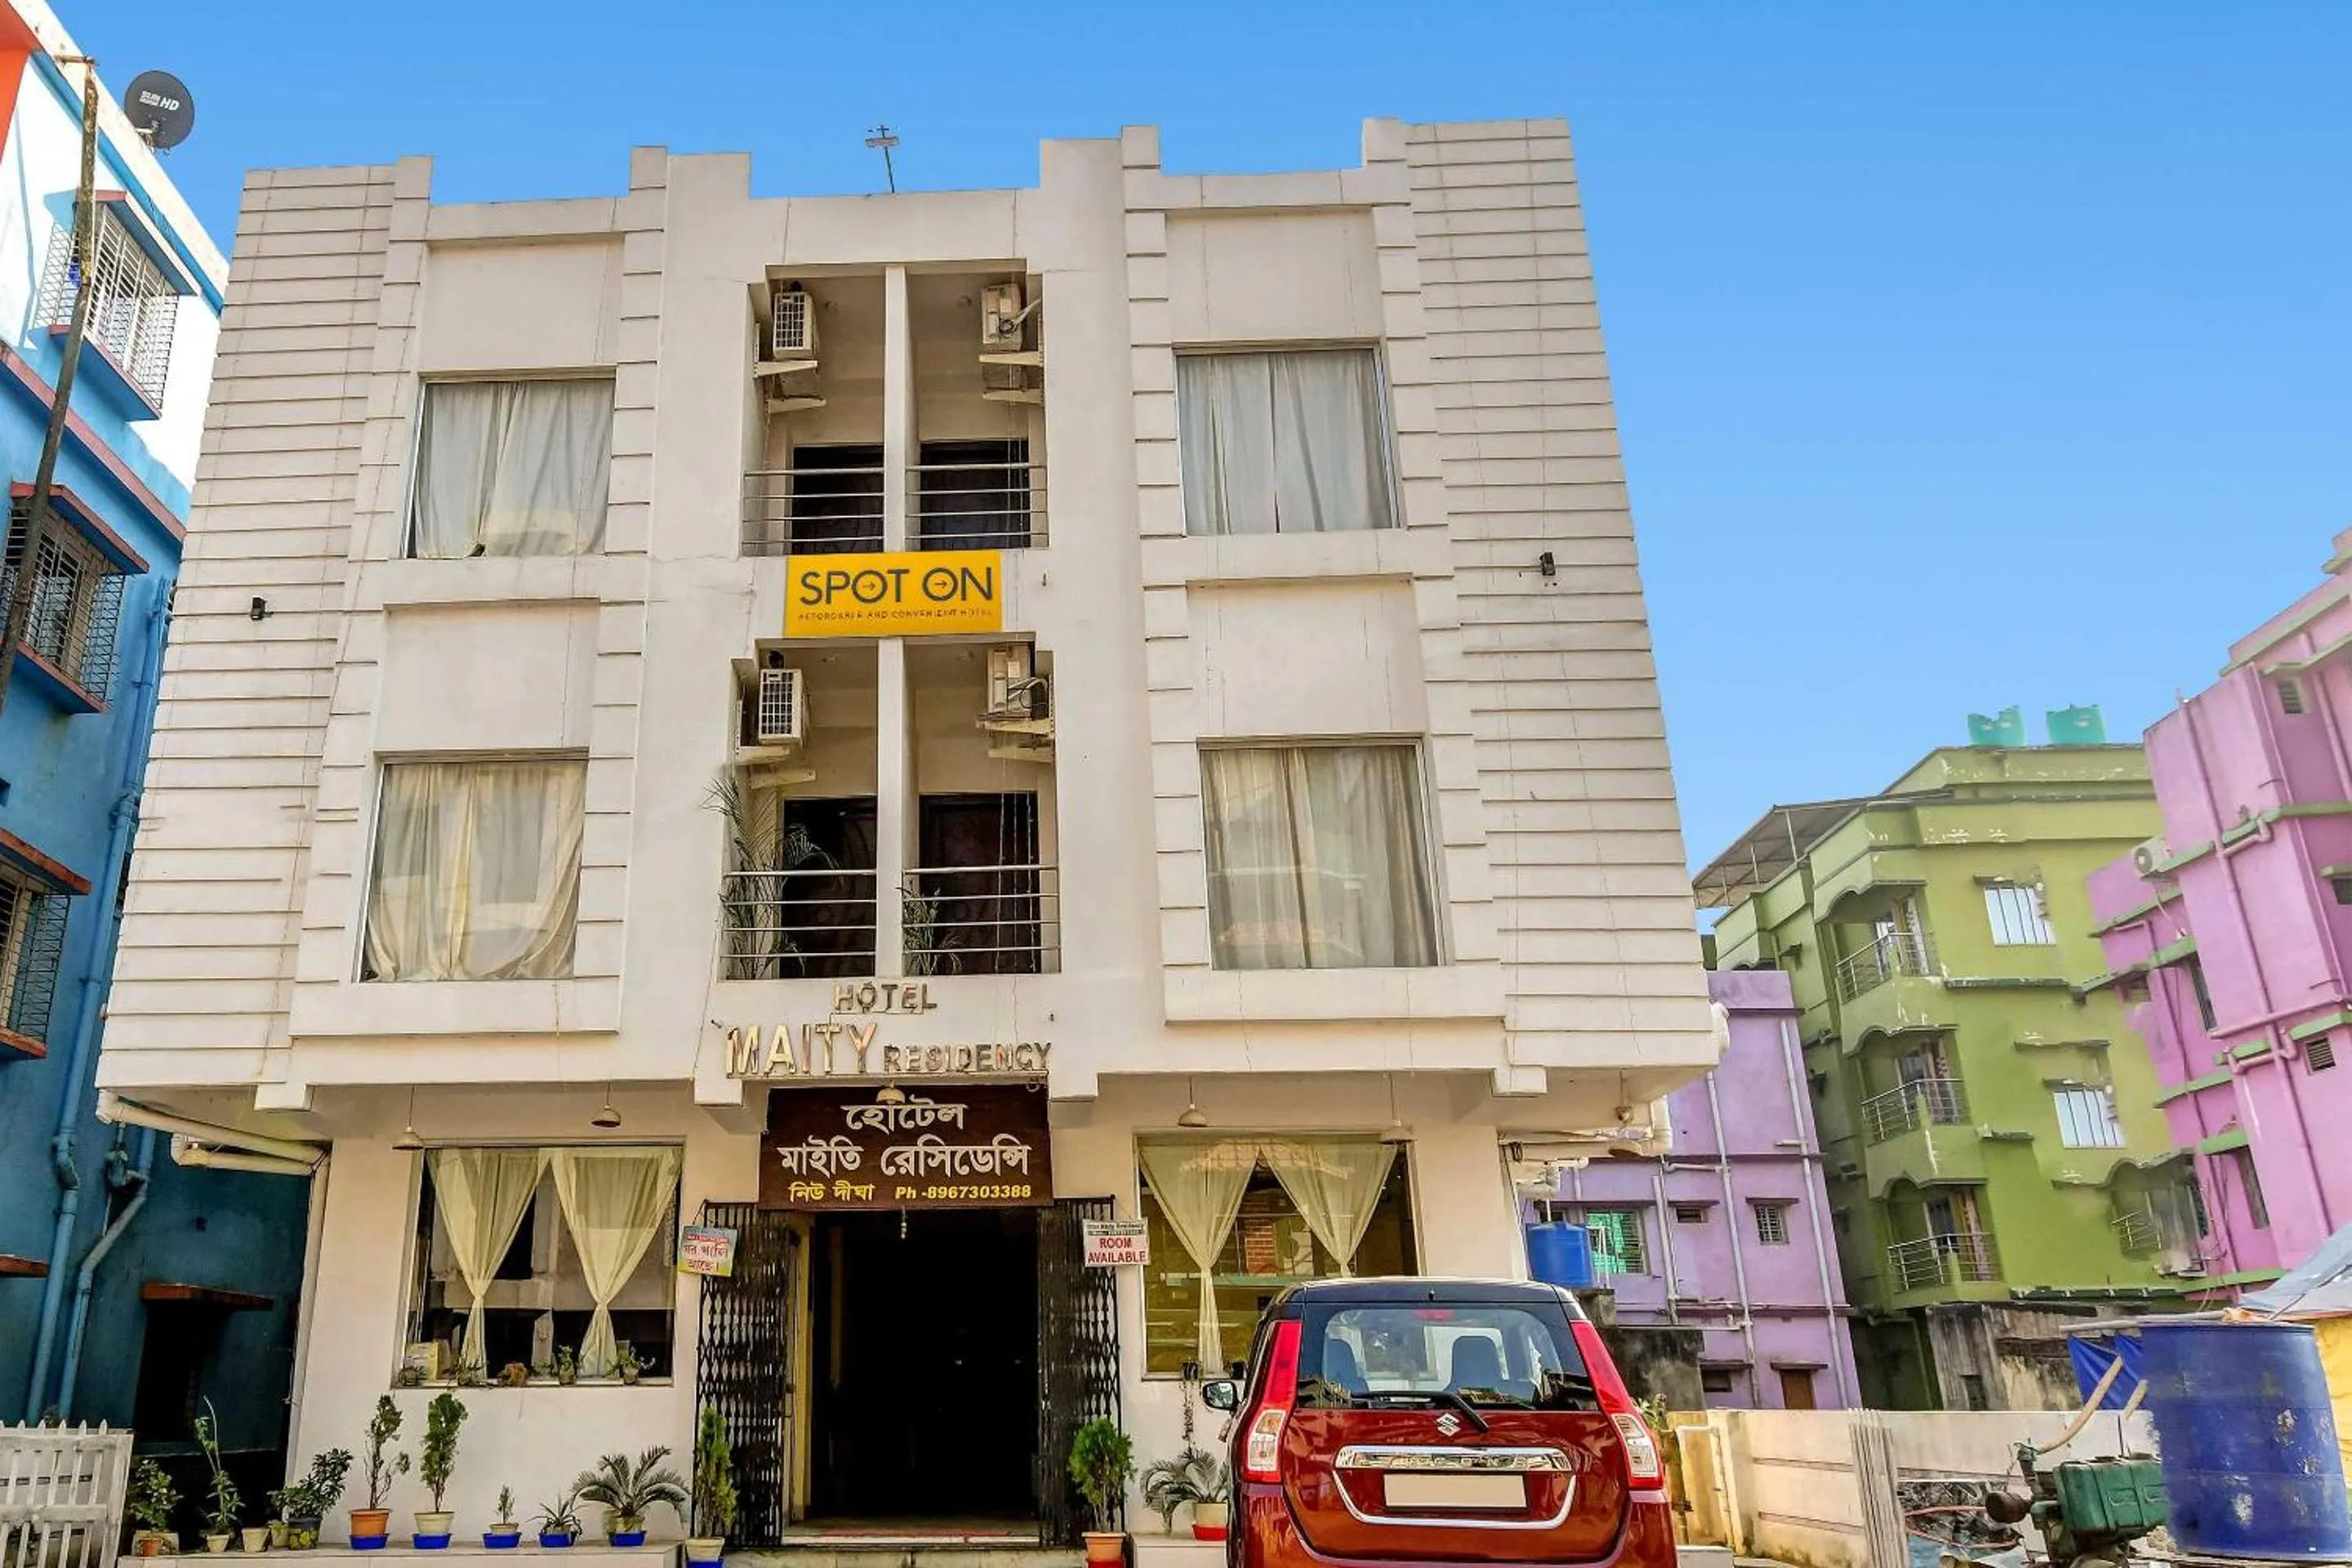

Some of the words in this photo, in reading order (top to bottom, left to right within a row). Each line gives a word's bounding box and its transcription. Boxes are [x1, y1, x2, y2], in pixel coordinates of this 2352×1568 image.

[159, 96, 179, 110] HD
[800, 569, 910, 605] SPOT
[922, 567, 993, 602] ON
[834, 982, 938, 1012] HOTEL
[726, 1022, 877, 1076] MAITY
[884, 1042, 1051, 1072] RESIDENCY
[840, 1094, 969, 1134] হোটেল
[777, 1134, 864, 1178] মাইতি
[880, 1133, 1033, 1177] রেসিডেন্সি
[788, 1181, 826, 1203] নিউ
[832, 1180, 875, 1201] দীঘা
[895, 1186, 916, 1199] Ph
[1088, 1251, 1146, 1263] AVAILABLE
[1099, 1237, 1131, 1249] ROOM
